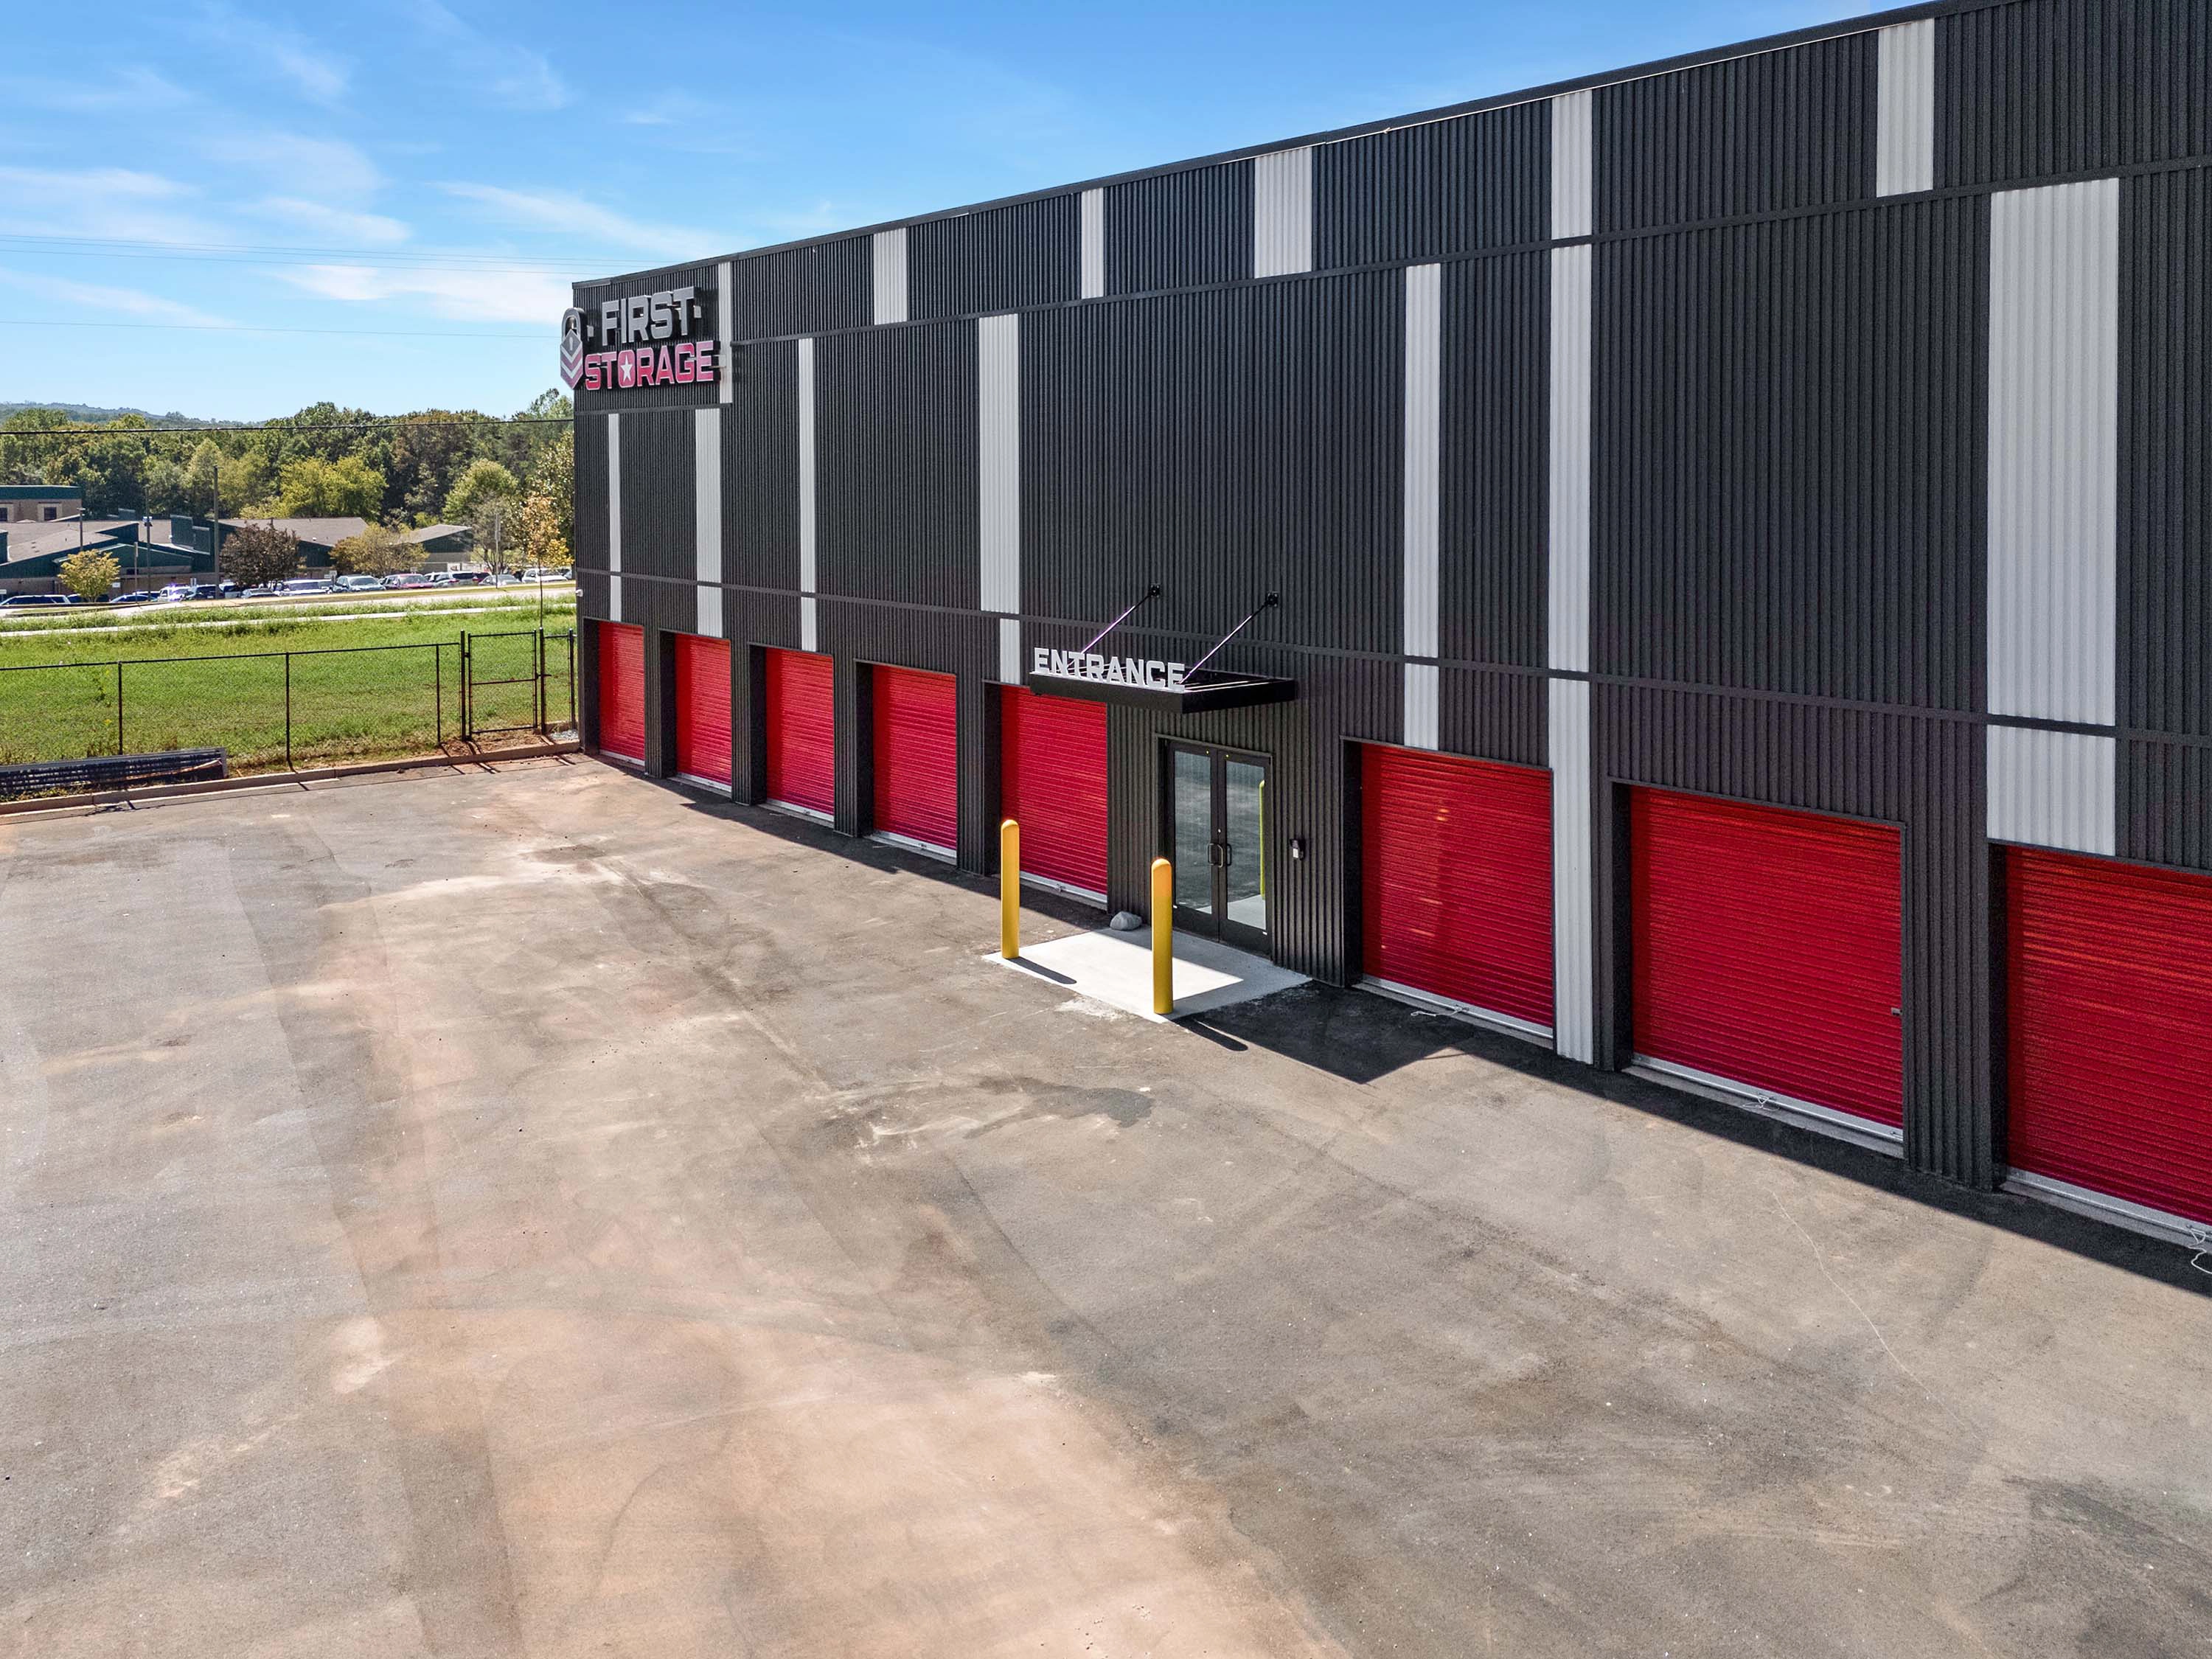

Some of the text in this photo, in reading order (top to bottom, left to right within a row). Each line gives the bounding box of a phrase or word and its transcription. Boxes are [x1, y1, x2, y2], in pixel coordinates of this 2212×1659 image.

[602, 286, 695, 346] FIRST
[585, 340, 714, 390] STORAGE
[1034, 647, 1186, 691] ENTRANCE
